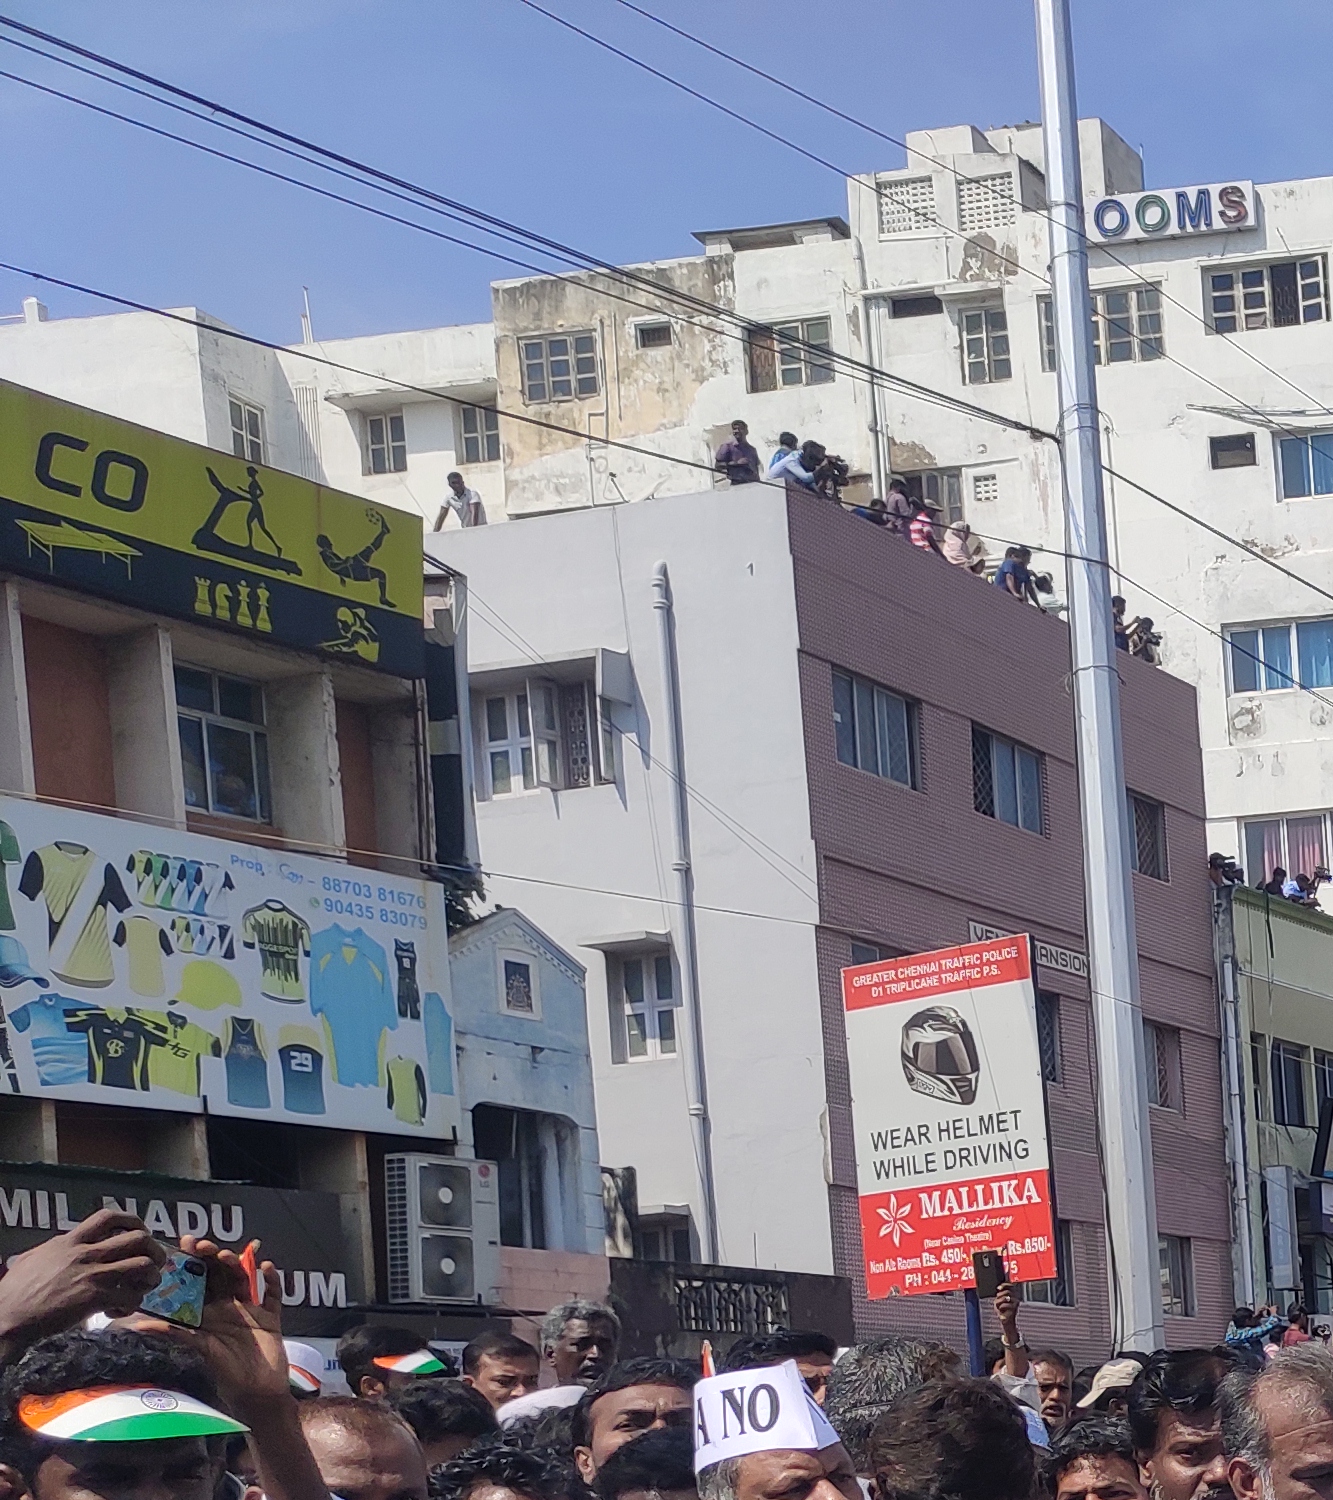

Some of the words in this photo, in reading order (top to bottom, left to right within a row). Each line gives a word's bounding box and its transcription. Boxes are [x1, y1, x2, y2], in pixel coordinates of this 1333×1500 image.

[1094, 185, 1249, 237] OOMS
[35, 431, 149, 513] CO
[322, 876, 372, 899] 88703
[377, 887, 427, 910] 81676
[324, 898, 374, 920] 90435
[379, 908, 427, 931] 83079
[853, 969, 897, 987] GREATER
[898, 961, 939, 979] CHENNAI
[940, 953, 980, 970] TRAFFIC
[982, 946, 1019, 964] POLICE
[871, 985, 884, 998] D1
[885, 976, 940, 995] TRIPLICANE
[941, 968, 981, 985] TRAFFIC
[983, 964, 1001, 978] P.S.
[289, 1051, 313, 1073] 29
[870, 1123, 933, 1152] WEAR
[938, 1109, 1022, 1142] HELMET
[873, 1152, 938, 1181] WHILE
[944, 1138, 1030, 1171] DRIVING
[0, 1186, 80, 1231] MIL
[918, 1177, 1042, 1219] MALLIKA
[953, 1214, 1013, 1232] Residency
[905, 1272, 922, 1288] PH
[931, 1268, 951, 1284] 044
[922, 1251, 939, 1267] Rs.
[258, 1267, 348, 1308] UM
[720, 1383, 780, 1440] NO
